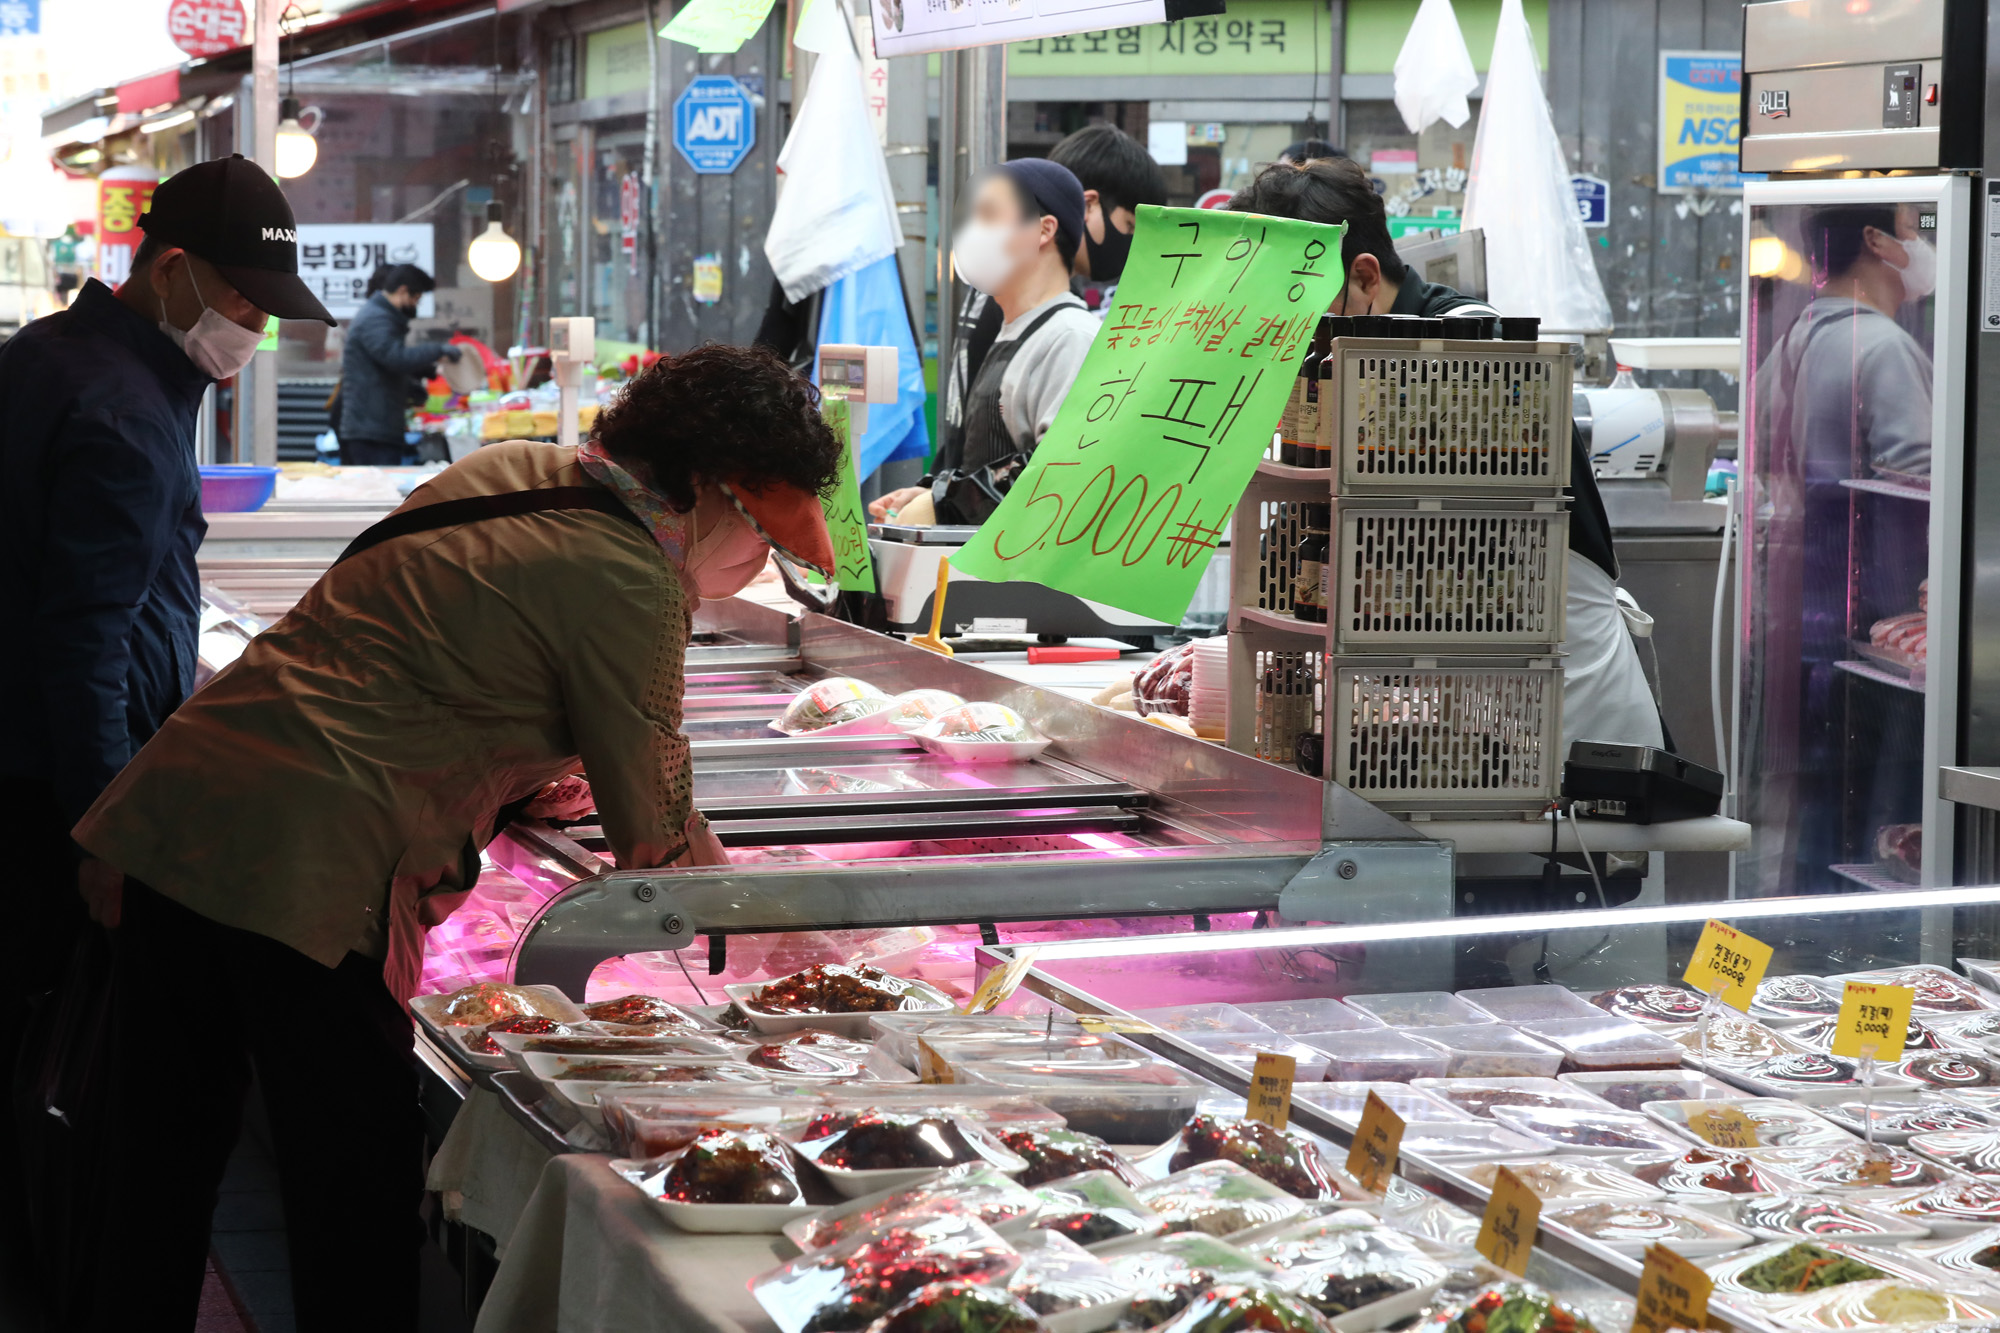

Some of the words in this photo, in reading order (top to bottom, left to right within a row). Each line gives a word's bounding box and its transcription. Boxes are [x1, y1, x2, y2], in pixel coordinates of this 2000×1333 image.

[171, 2, 243, 44] 순대국
[1159, 20, 1287, 55] 지정약국
[1689, 70, 1727, 84] CCTV
[686, 106, 742, 141] ADT
[301, 241, 388, 270] 부침개
[1240, 311, 1312, 362] 갈비살
[1708, 957, 1746, 988] 10,000원
[1855, 1020, 1890, 1039] 5,000원
